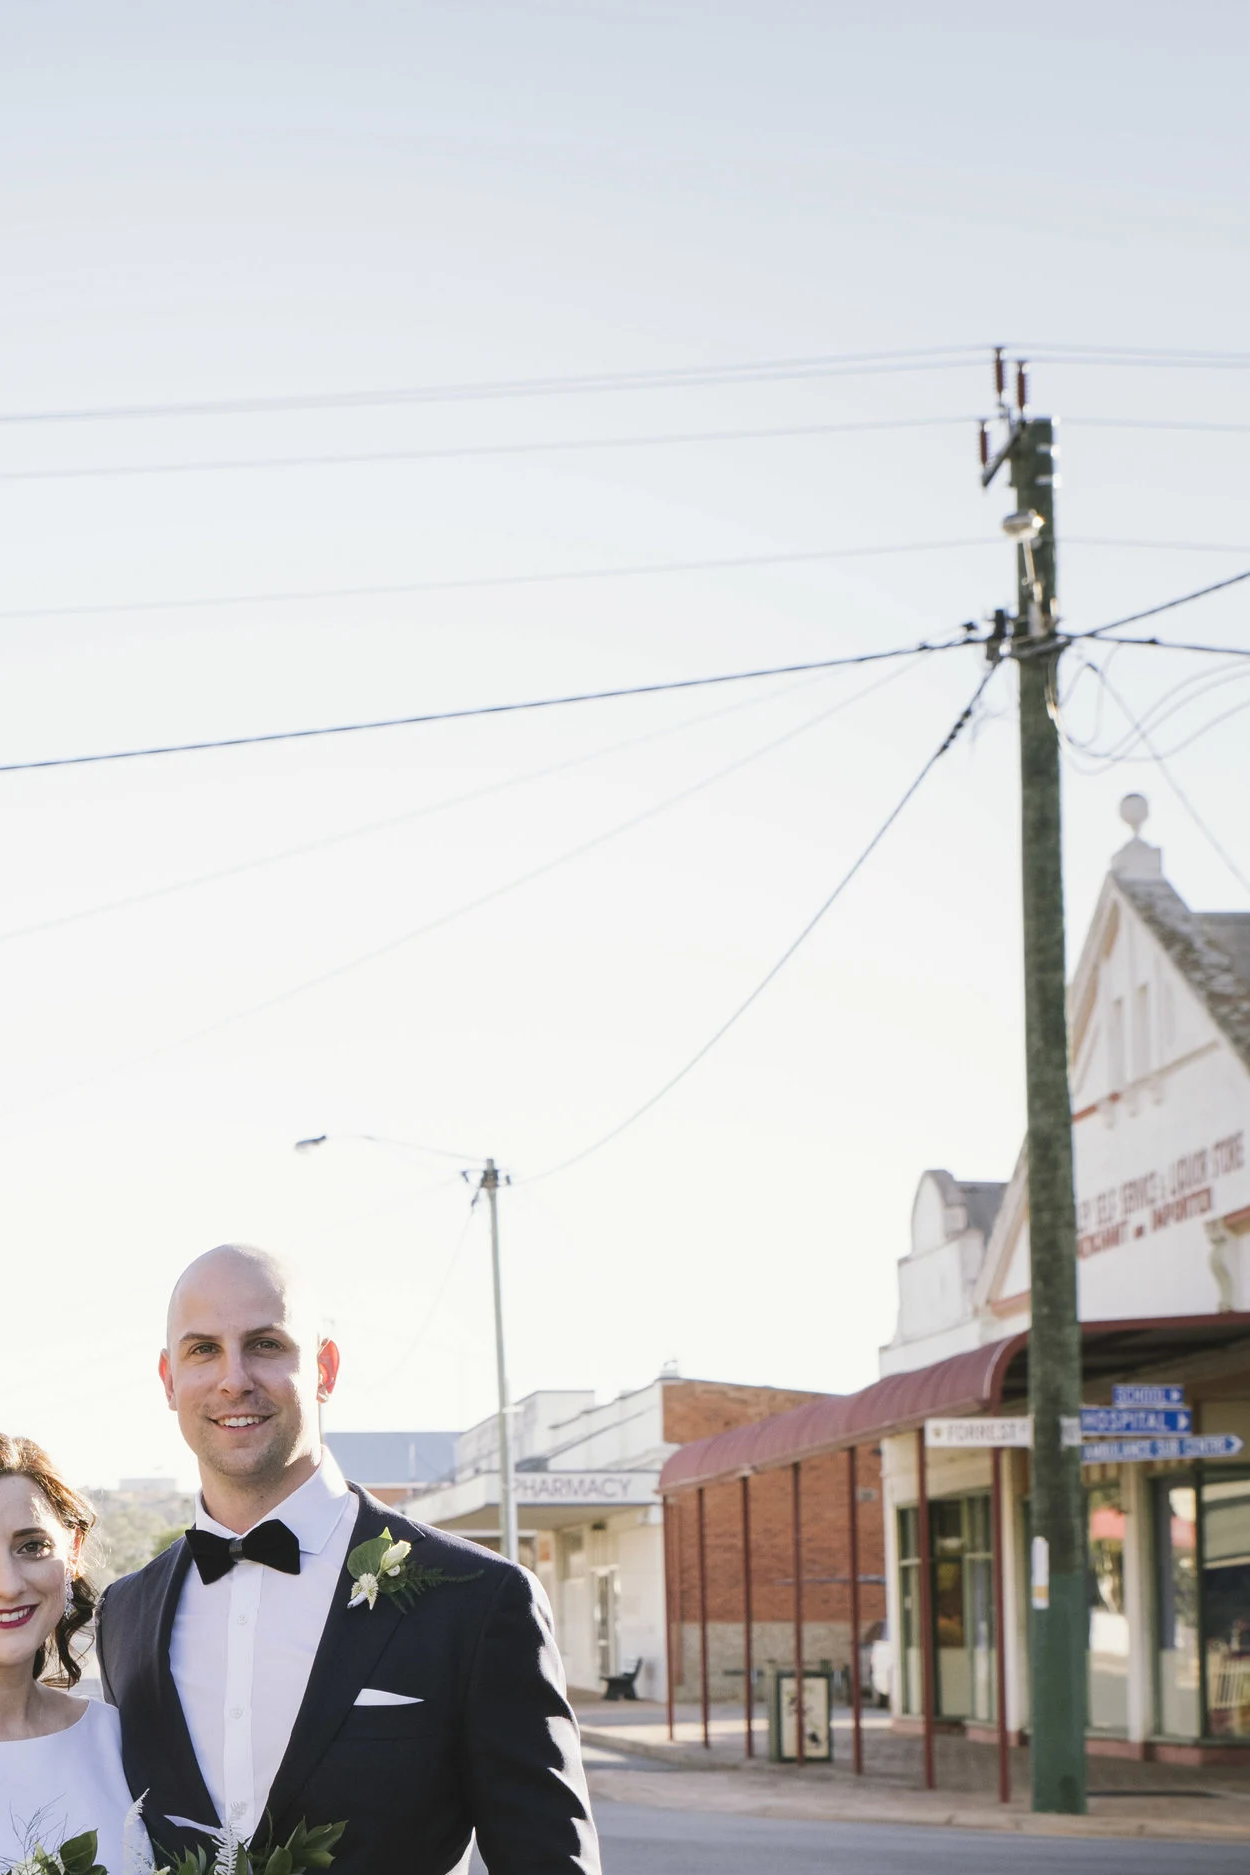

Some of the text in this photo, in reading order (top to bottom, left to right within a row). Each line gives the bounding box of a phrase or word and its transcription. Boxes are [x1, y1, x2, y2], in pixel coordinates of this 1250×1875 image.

[1214, 1130, 1244, 1178] STORE
[1116, 1387, 1166, 1402] SCHOOL
[1081, 1411, 1171, 1431] HOSPITAL
[947, 1422, 1017, 1441] FORREST
